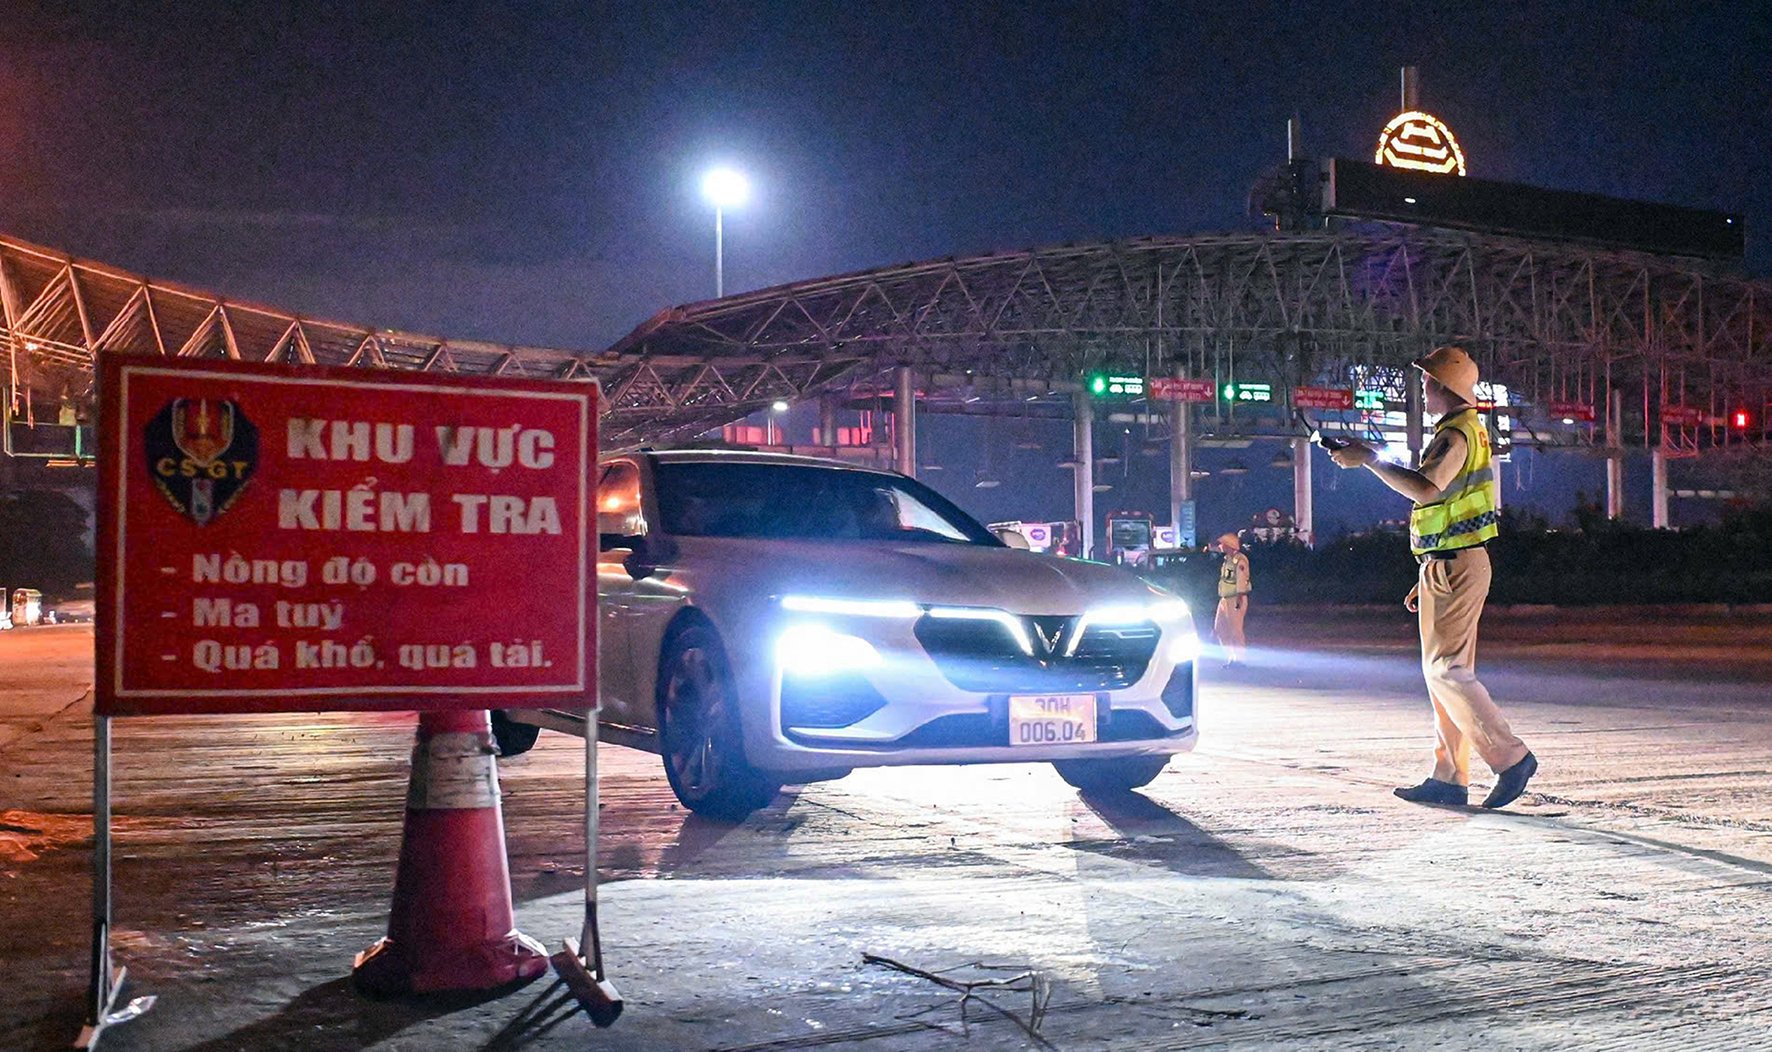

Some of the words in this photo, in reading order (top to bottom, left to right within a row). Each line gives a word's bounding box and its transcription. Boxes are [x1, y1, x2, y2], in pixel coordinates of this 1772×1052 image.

[287, 417, 415, 464] KHU
[435, 423, 555, 474] VỰC
[278, 476, 431, 533] KIỂM
[452, 493, 562, 534] TRA
[322, 556, 377, 592] độ
[193, 597, 260, 628] Ma
[193, 639, 280, 673] Quá
[398, 640, 477, 671] quá
[1020, 720, 1086, 743] 006.04
